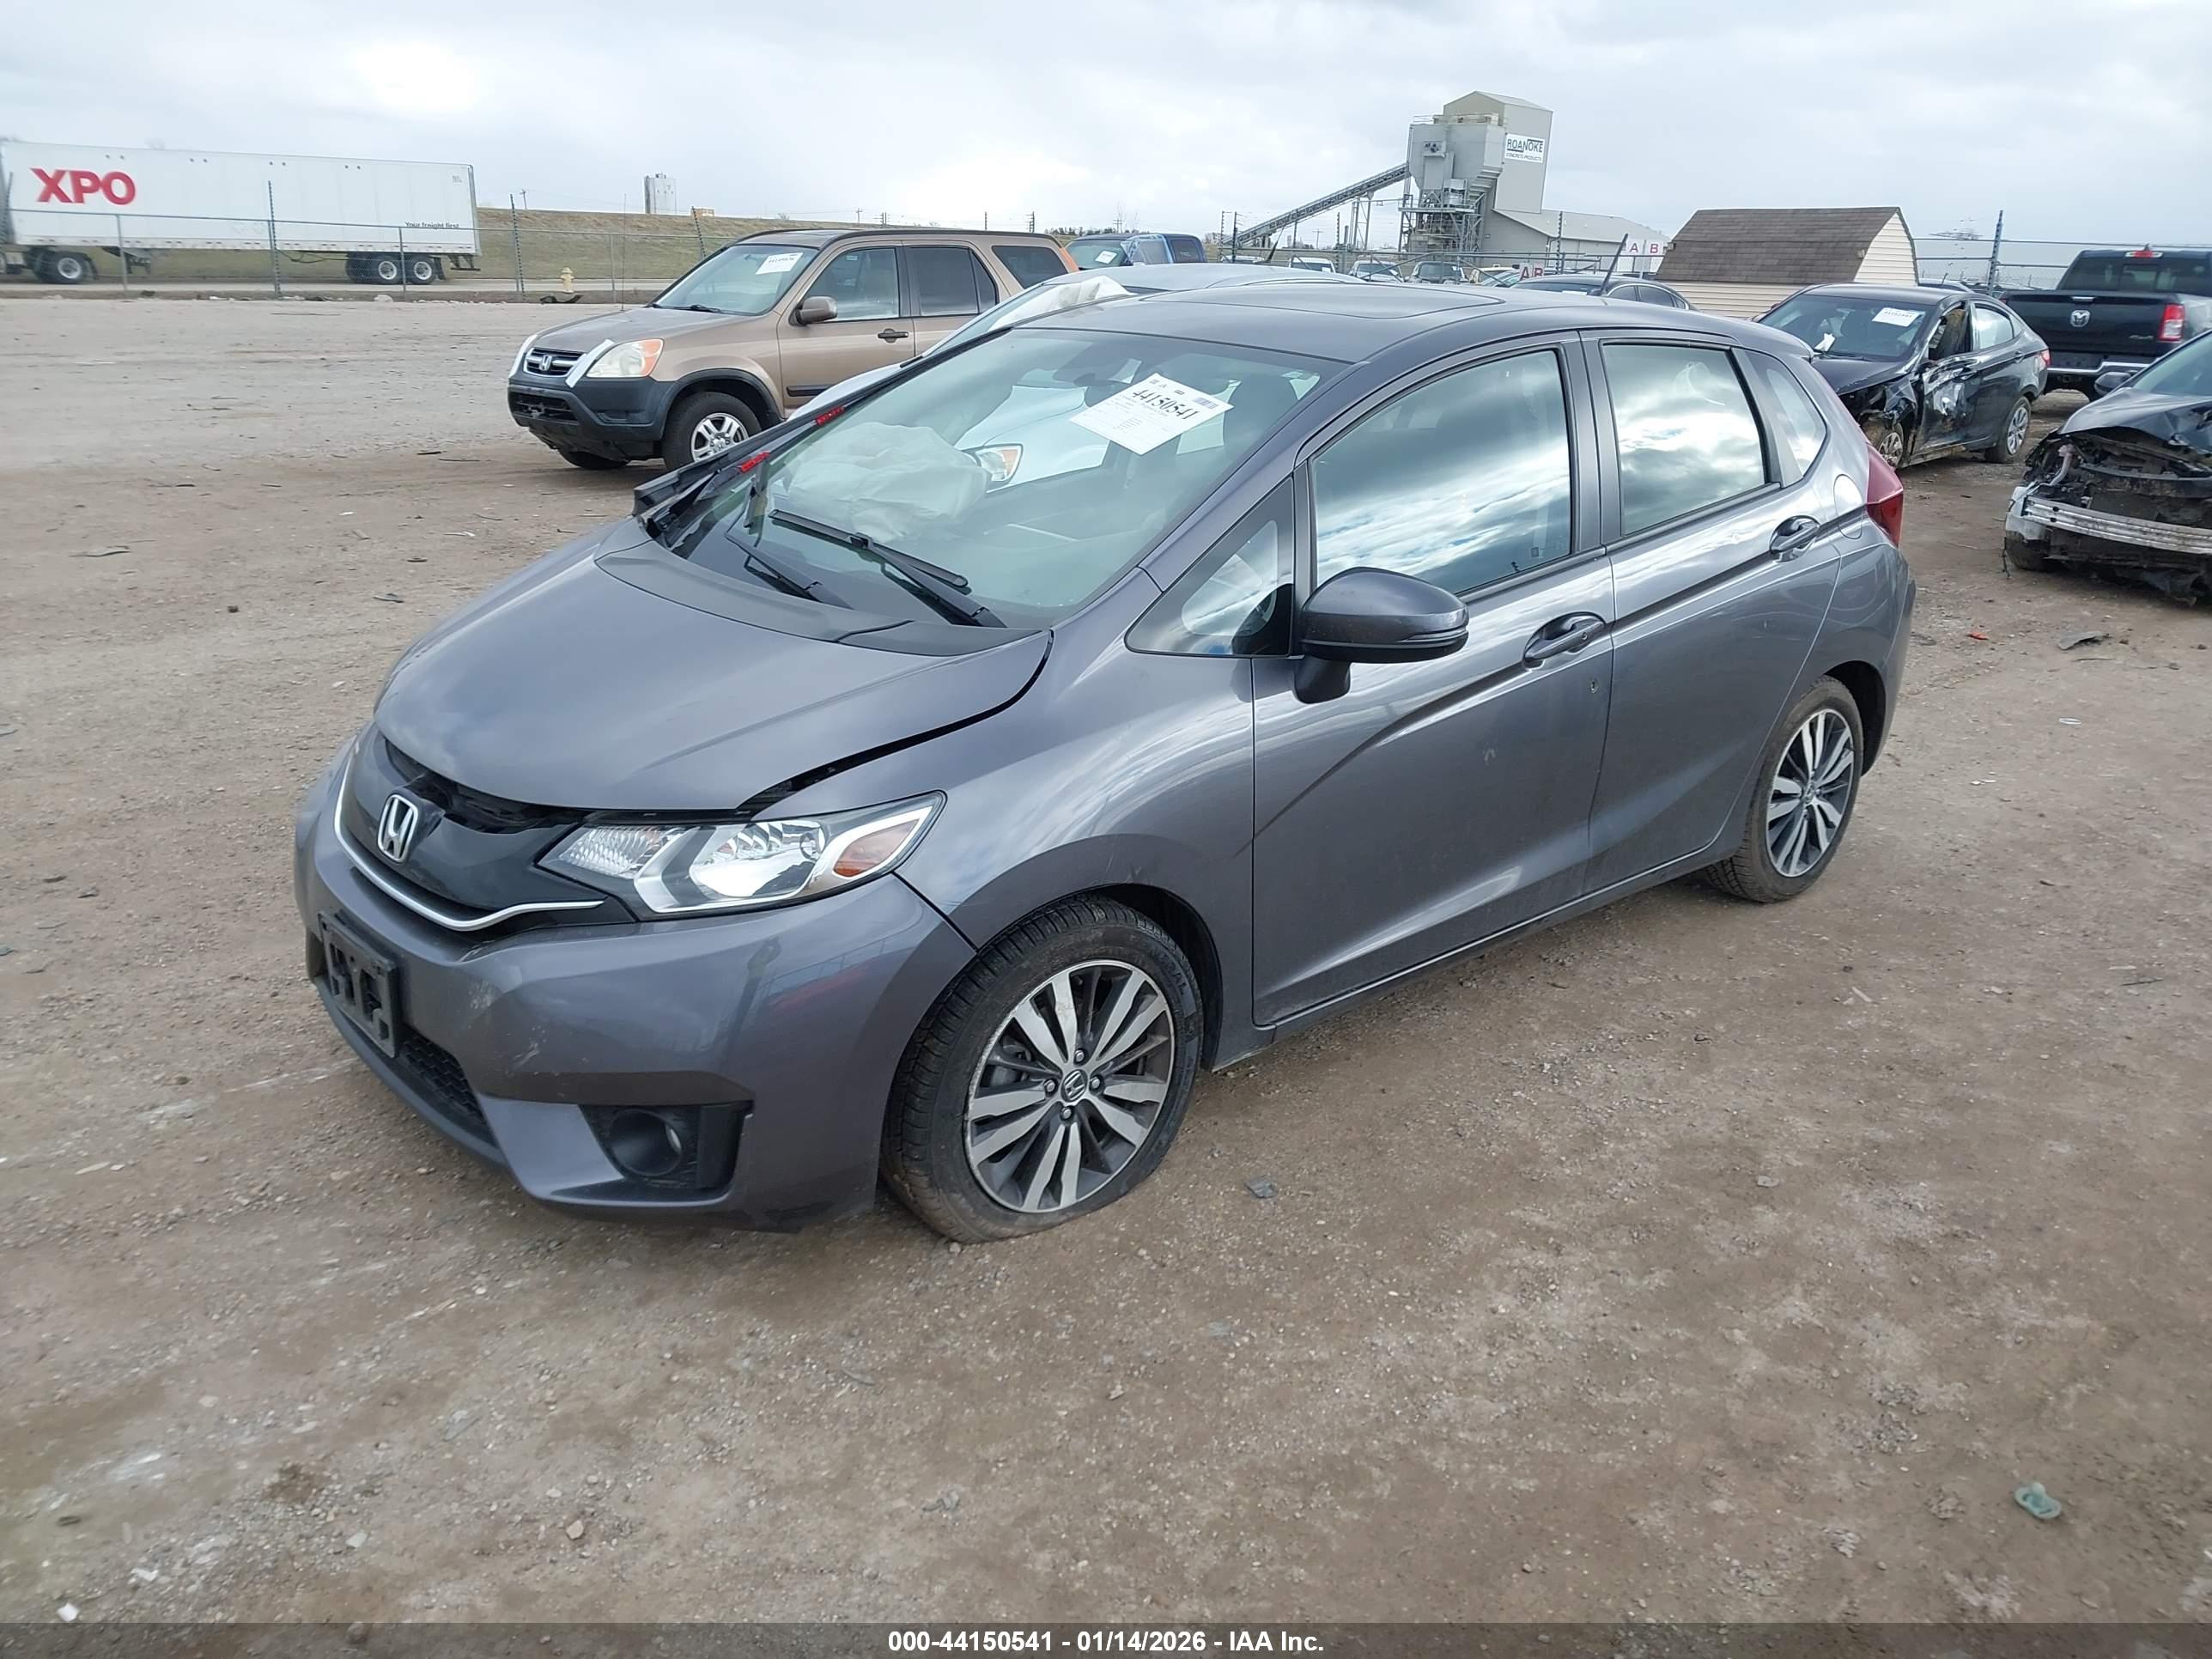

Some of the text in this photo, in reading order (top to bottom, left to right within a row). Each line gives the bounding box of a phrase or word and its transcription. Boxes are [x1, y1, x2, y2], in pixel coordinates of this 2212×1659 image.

[1507, 138, 1544, 153] ROANOKE
[29, 167, 136, 205] XPO
[1629, 242, 1659, 253] A B
[1520, 266, 1529, 281] A
[1133, 389, 1200, 419] 44150541
